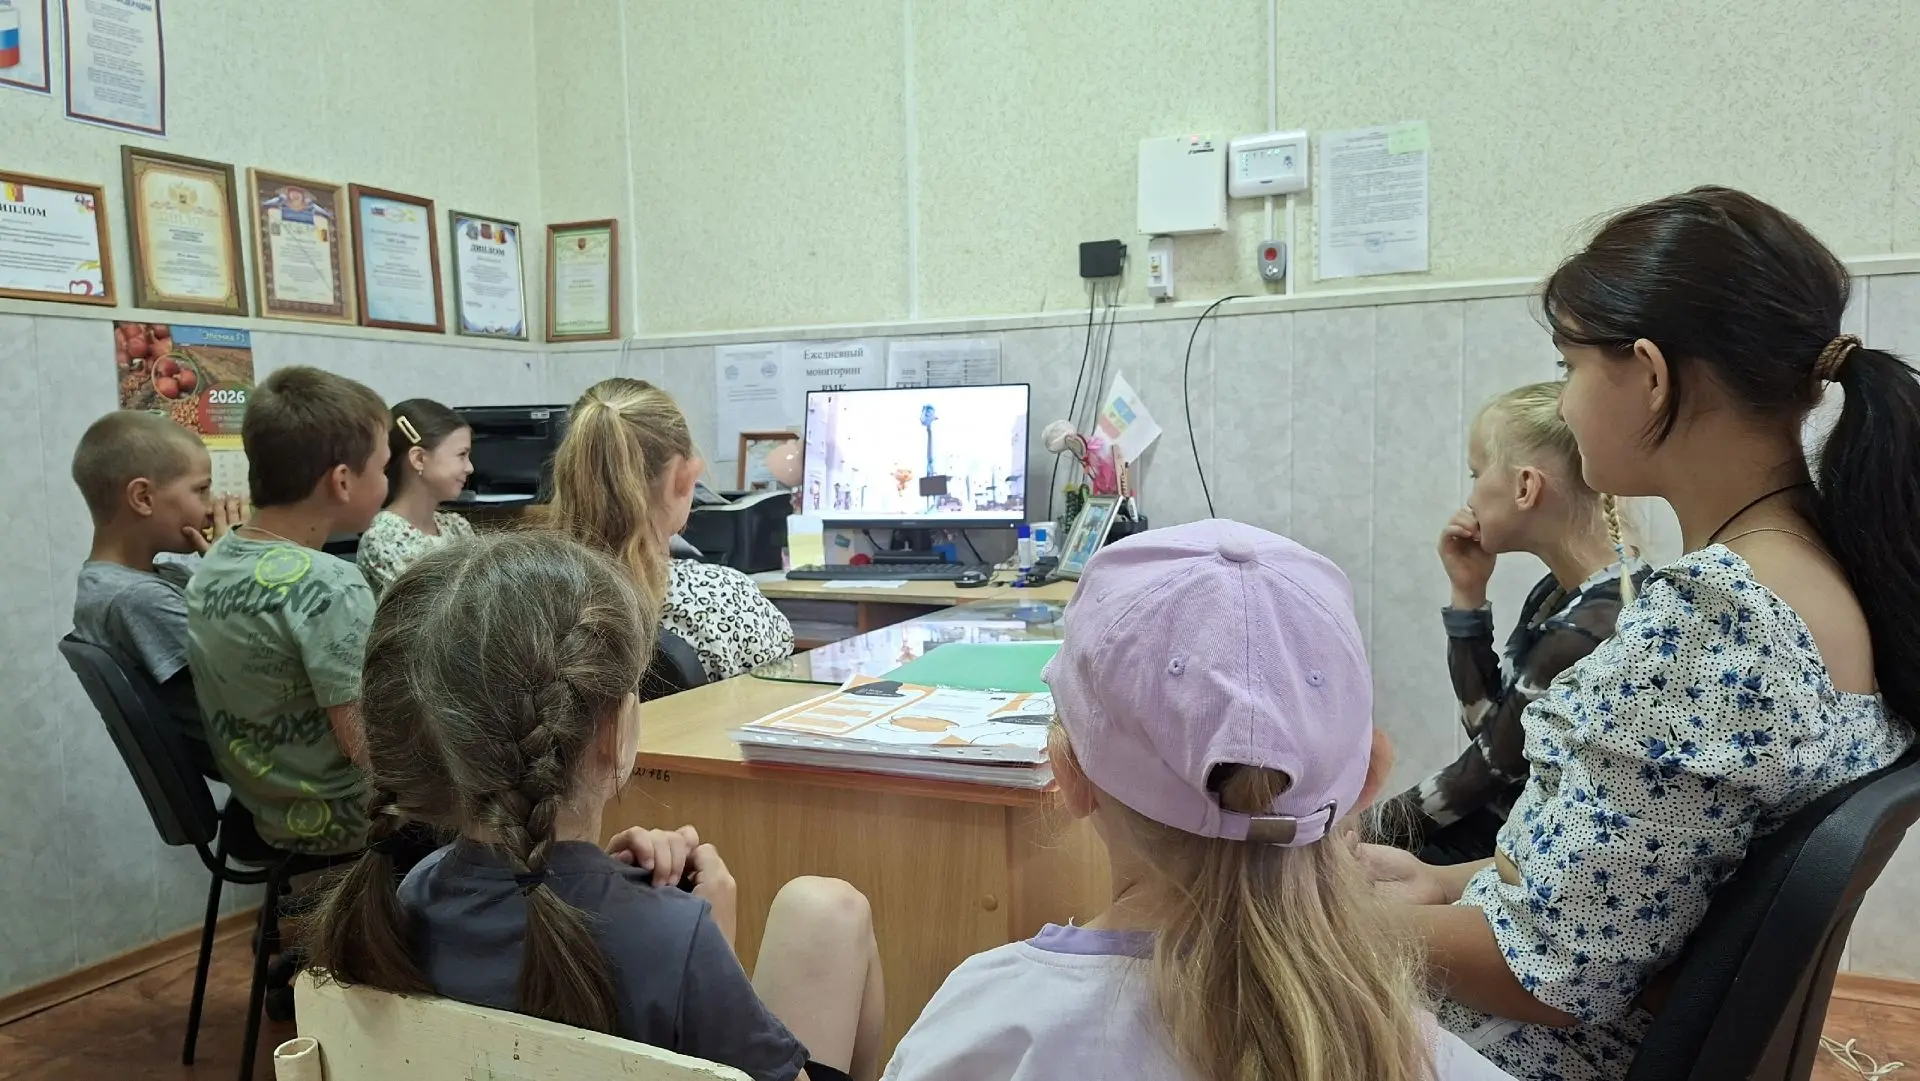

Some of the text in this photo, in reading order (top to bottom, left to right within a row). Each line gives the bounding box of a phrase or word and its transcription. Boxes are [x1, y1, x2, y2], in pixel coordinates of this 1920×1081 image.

[0, 203, 47, 218] ИПЛОМ
[470, 243, 506, 257] ДИПЛОМ
[803, 347, 864, 360] Ежедневный
[806, 367, 861, 378] мониторинг
[208, 389, 246, 404] 2026
